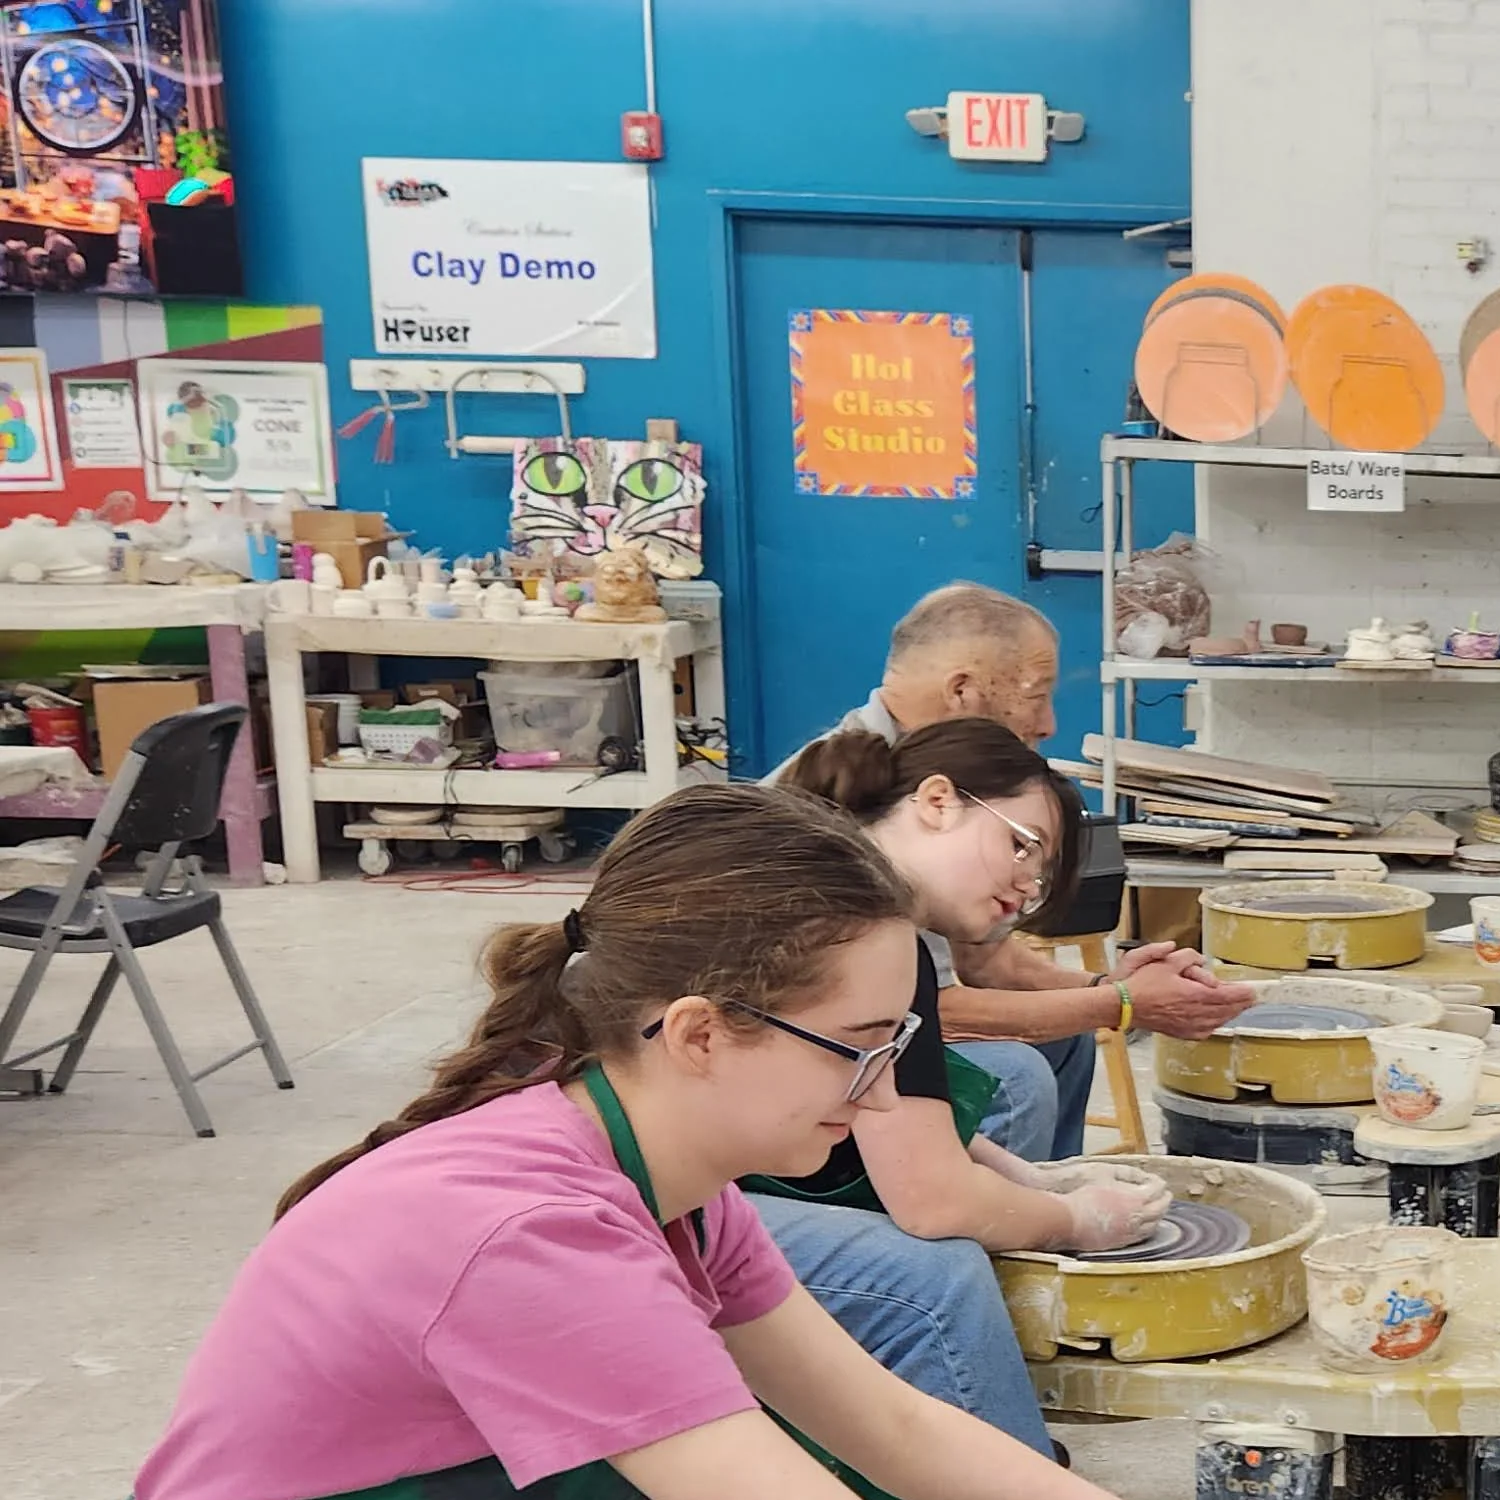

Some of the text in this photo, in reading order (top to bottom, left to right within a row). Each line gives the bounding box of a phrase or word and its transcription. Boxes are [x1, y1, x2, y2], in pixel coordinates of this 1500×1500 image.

[966, 97, 1030, 149] EXIT
[412, 250, 597, 286] Clay Demo
[851, 353, 913, 382] Hot
[833, 389, 935, 418] Glass
[823, 425, 946, 455] Studio
[1310, 459, 1401, 477] Bats/ Ware
[1327, 483, 1384, 500] Boards
